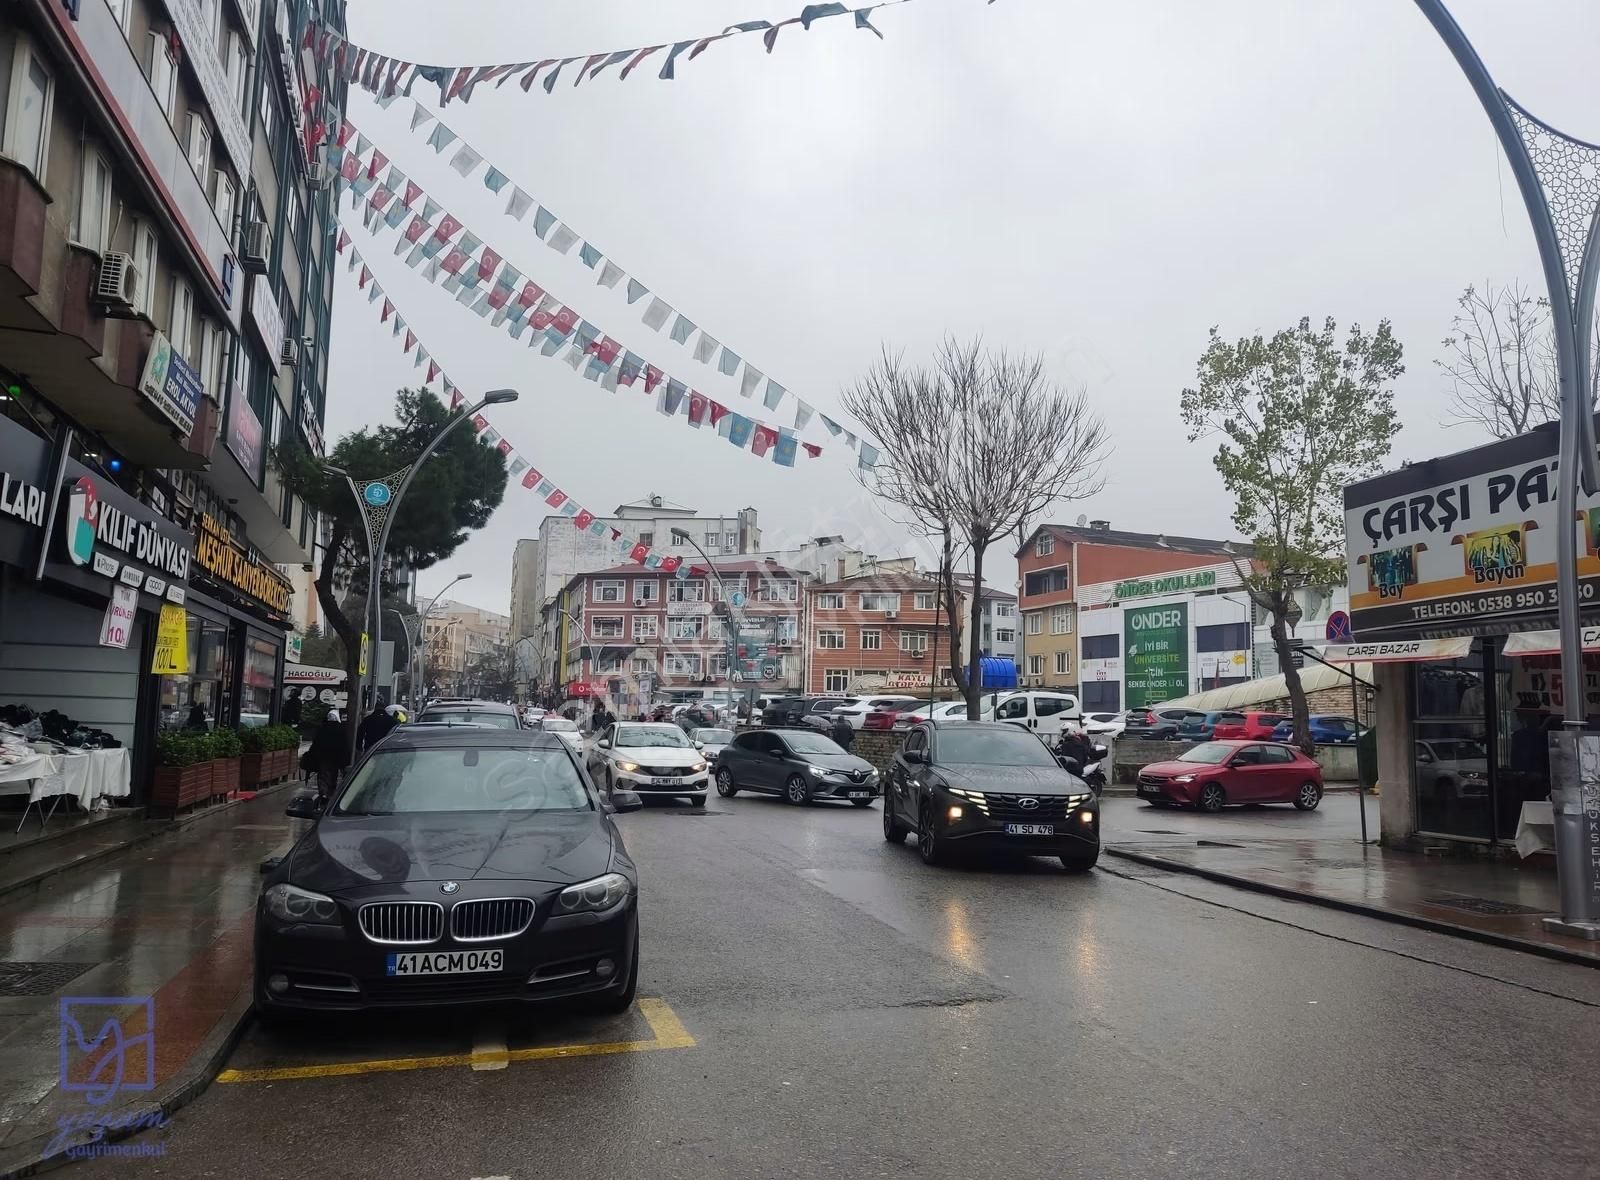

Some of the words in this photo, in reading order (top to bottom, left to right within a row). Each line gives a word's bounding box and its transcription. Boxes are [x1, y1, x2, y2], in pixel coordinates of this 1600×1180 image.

[166, 377, 181, 402] EROL
[0, 472, 46, 527] LARI
[1362, 483, 1470, 548] ÇARŞI
[97, 501, 137, 553] KILIF
[136, 521, 190, 580] DÜNYASI
[1114, 580, 1153, 598] ÖNDER
[1155, 571, 1216, 593] OKULLARI
[1474, 564, 1525, 586] Bayan
[1379, 583, 1404, 599] Bay
[1412, 602, 1476, 619] TELEFON:
[1478, 596, 1512, 612] 0538
[1516, 590, 1545, 607] 950
[1156, 640, 1168, 650] BİR
[1380, 644, 1420, 654] BAZAR
[288, 670, 331, 678] HACIOĞLU
[1038, 826, 1052, 834] 478
